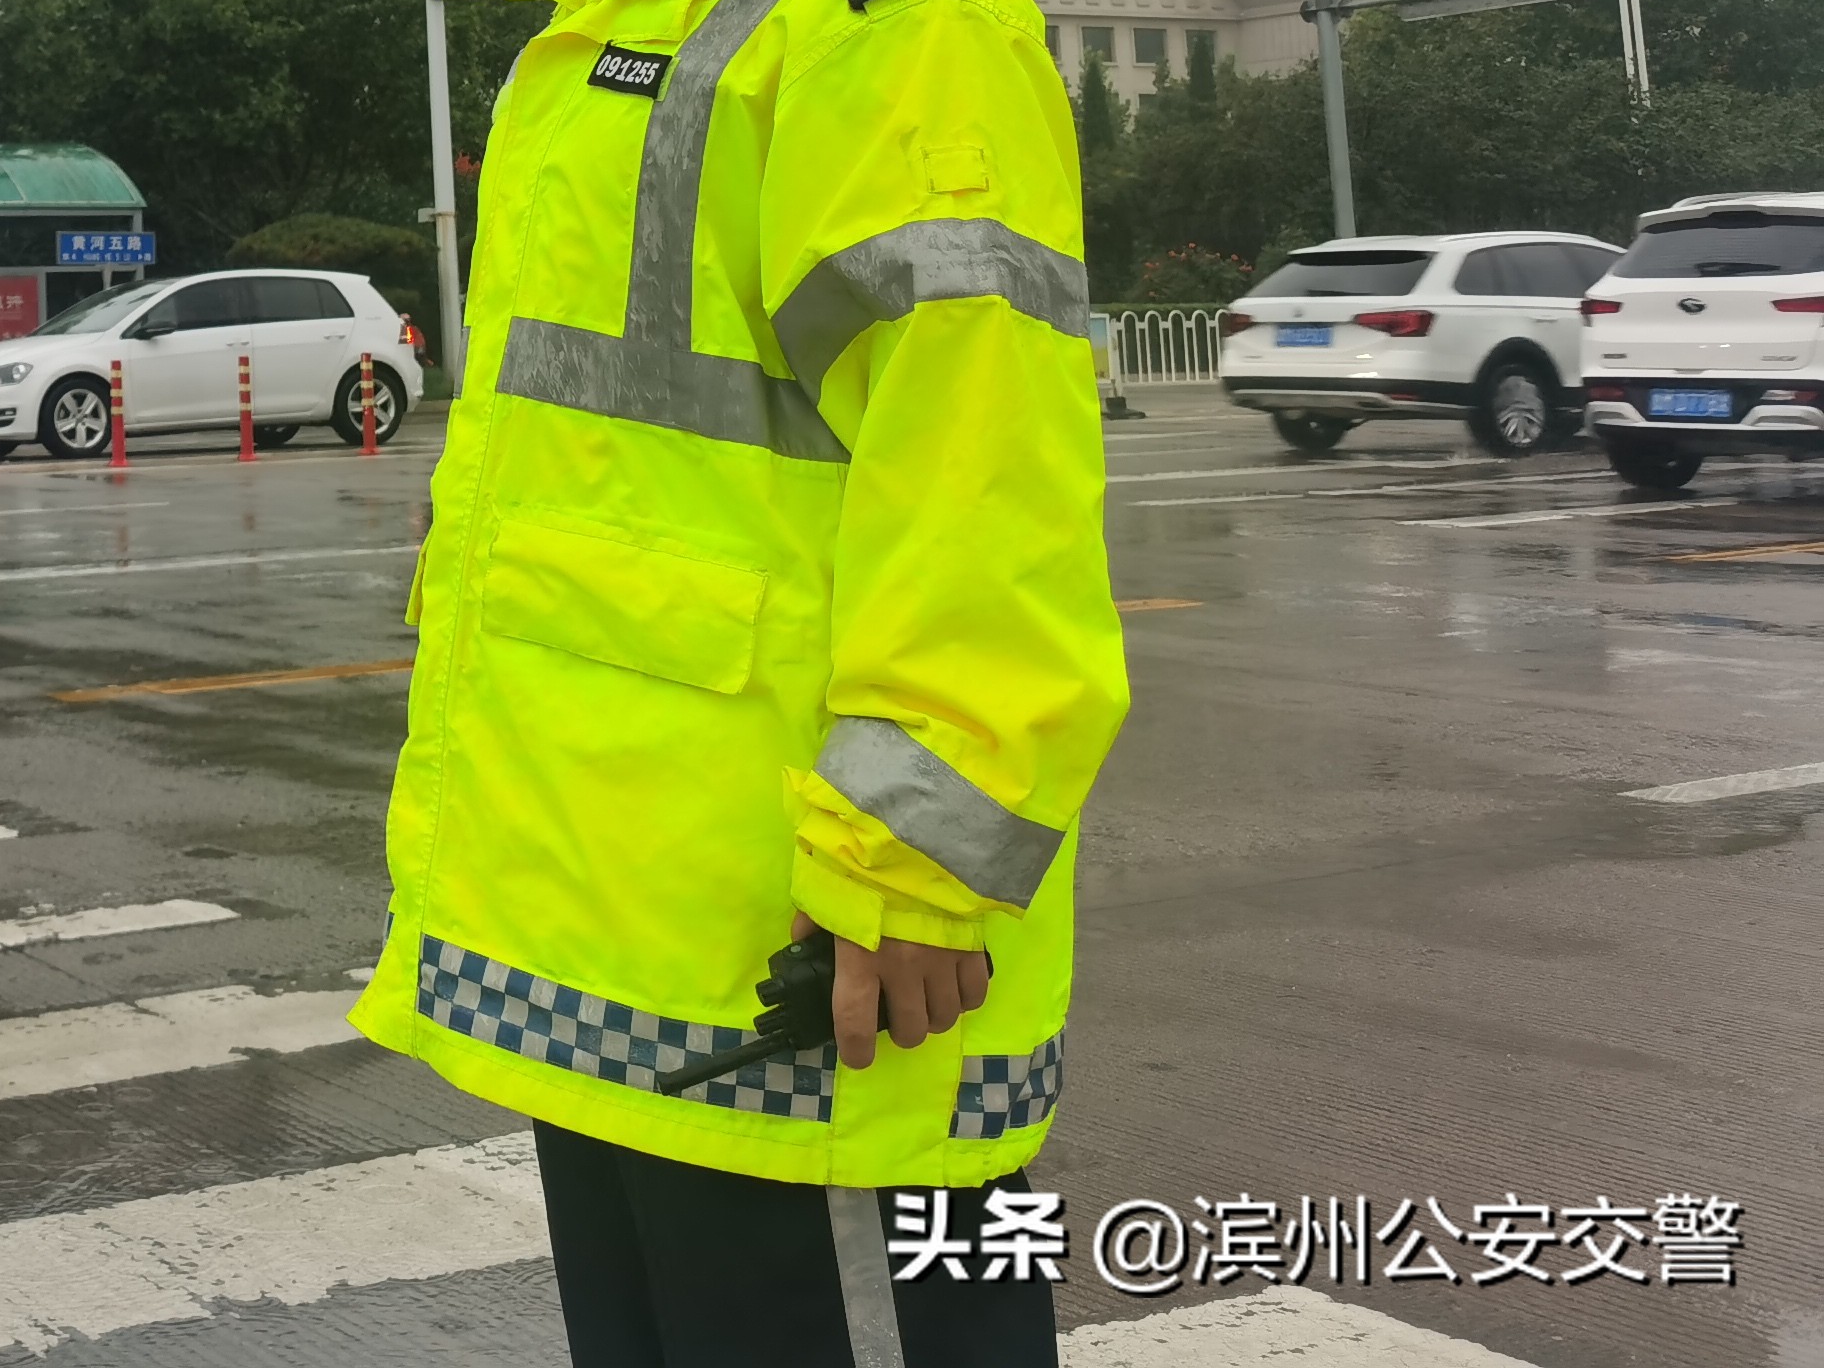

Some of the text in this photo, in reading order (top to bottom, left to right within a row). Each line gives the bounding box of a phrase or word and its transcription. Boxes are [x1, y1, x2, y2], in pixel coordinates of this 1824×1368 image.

[596, 54, 660, 85] 091255
[72, 235, 142, 251] 黄河五路
